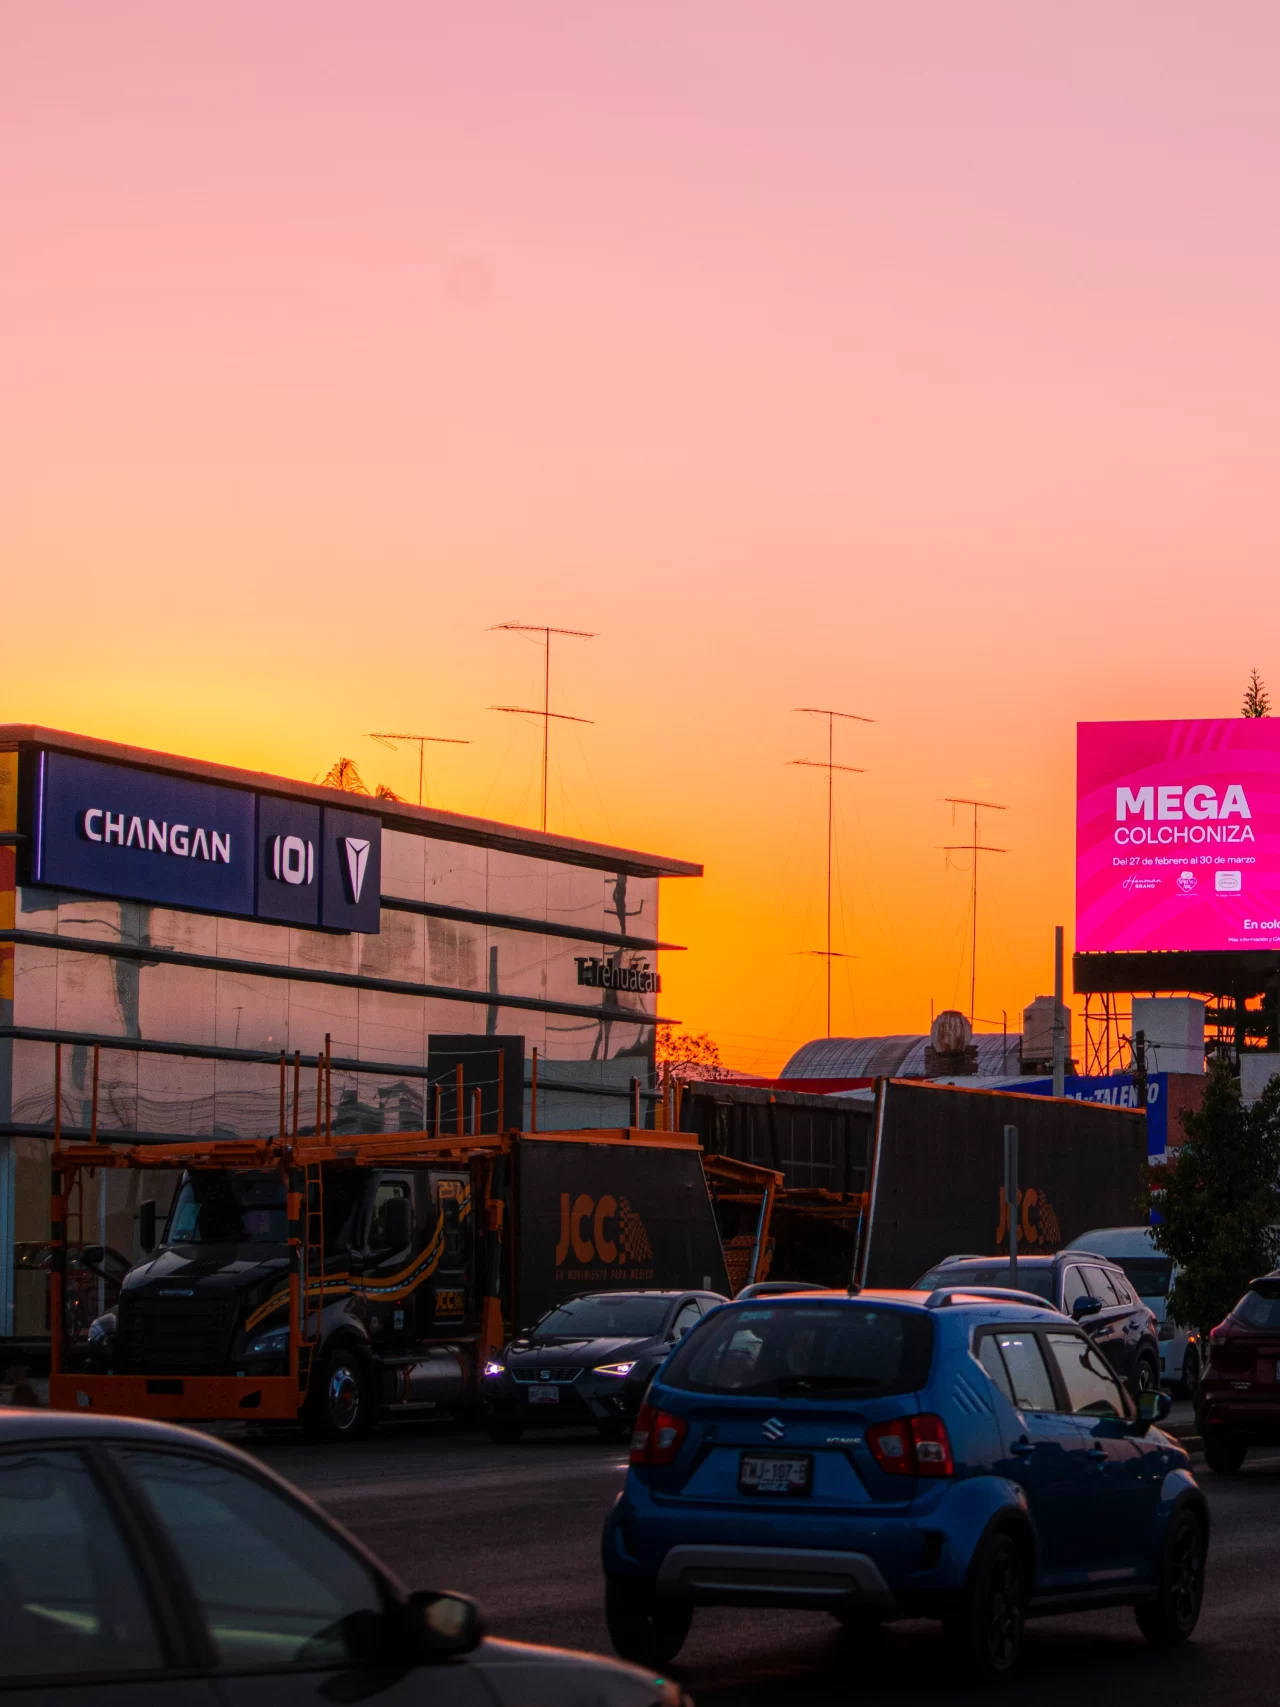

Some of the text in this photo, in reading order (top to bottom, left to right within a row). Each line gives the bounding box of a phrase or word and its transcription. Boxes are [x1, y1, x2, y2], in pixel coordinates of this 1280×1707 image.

[1116, 784, 1252, 821] MEGA
[84, 808, 231, 864] CHANGAN
[1114, 825, 1255, 845] COLCHONIZA
[1113, 855, 1256, 866] Del 27 de febrero al 30 de marzo
[1243, 919, 1259, 930] En
[1094, 1082, 1160, 1108] TALENO
[556, 1192, 617, 1266] JCC
